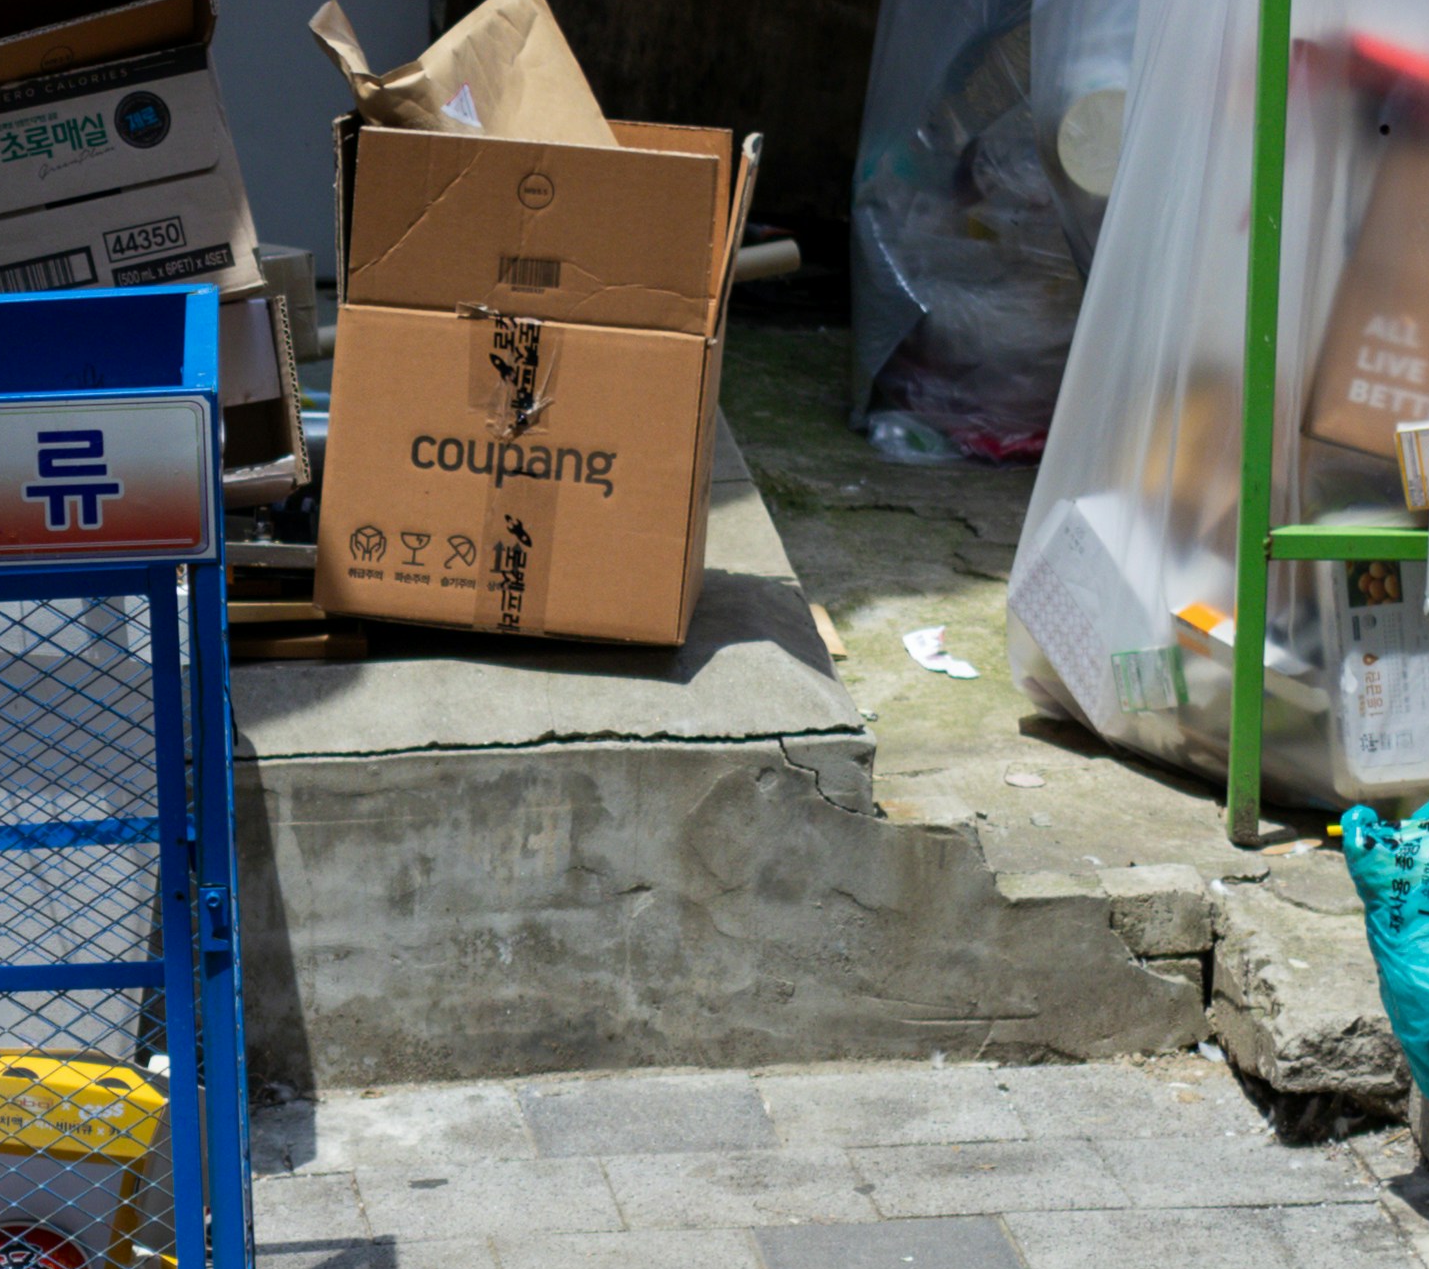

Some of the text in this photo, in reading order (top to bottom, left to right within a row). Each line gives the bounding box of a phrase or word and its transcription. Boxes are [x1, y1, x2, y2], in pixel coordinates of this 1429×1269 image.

[45, 68, 130, 93] CALORIES
[0, 112, 110, 164] 초록매실
[111, 221, 181, 257] 44350
[1363, 314, 1420, 348] ALL
[1356, 344, 1427, 384] LIVE
[410, 433, 618, 498] coupang
